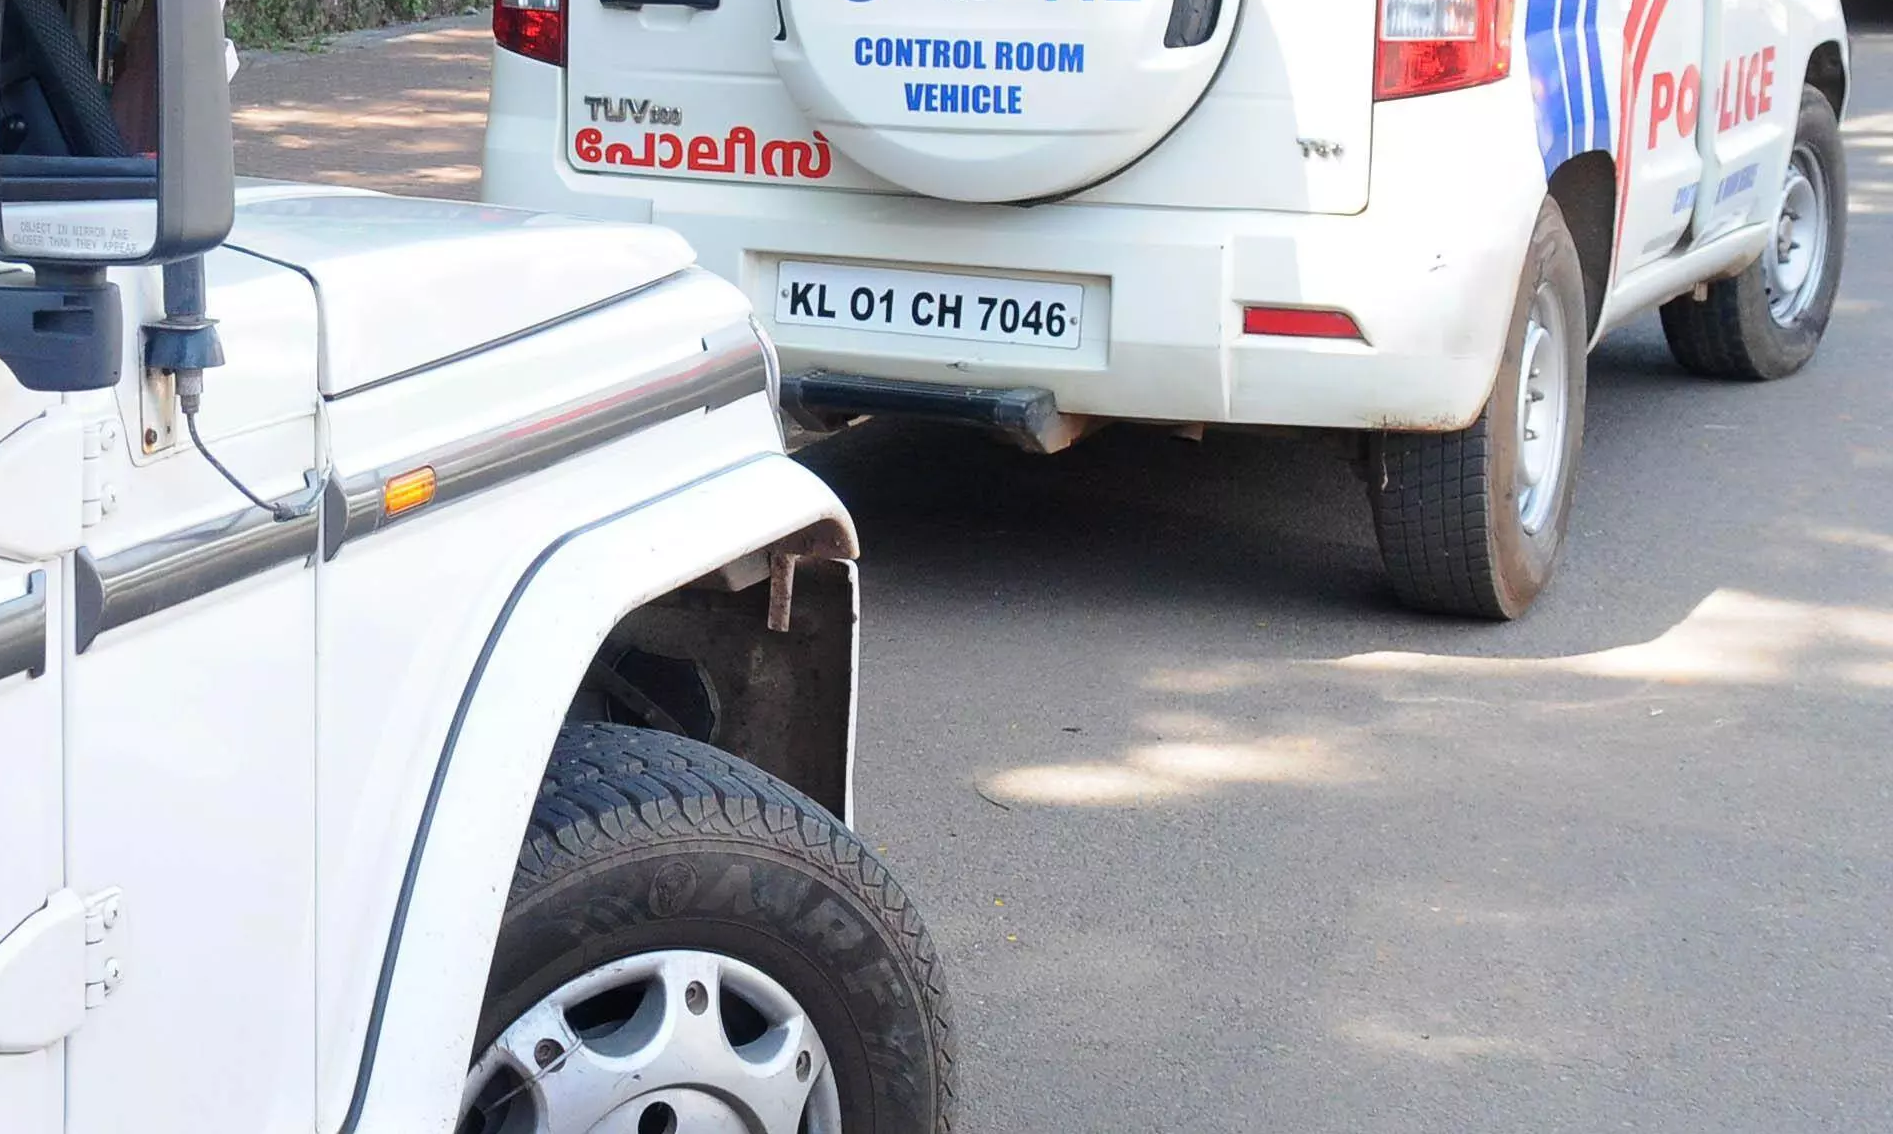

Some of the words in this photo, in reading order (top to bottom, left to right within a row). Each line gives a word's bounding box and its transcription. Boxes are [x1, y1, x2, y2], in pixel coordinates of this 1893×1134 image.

[854, 37, 987, 69] CONTROL
[995, 41, 1085, 73] ROOM
[904, 82, 1022, 114] VEHICLE
[1647, 45, 1775, 150] POLICE
[574, 126, 832, 179] പോലീസ്
[789, 282, 836, 319] KL
[911, 292, 963, 329] CH
[978, 297, 1066, 337] 7046
